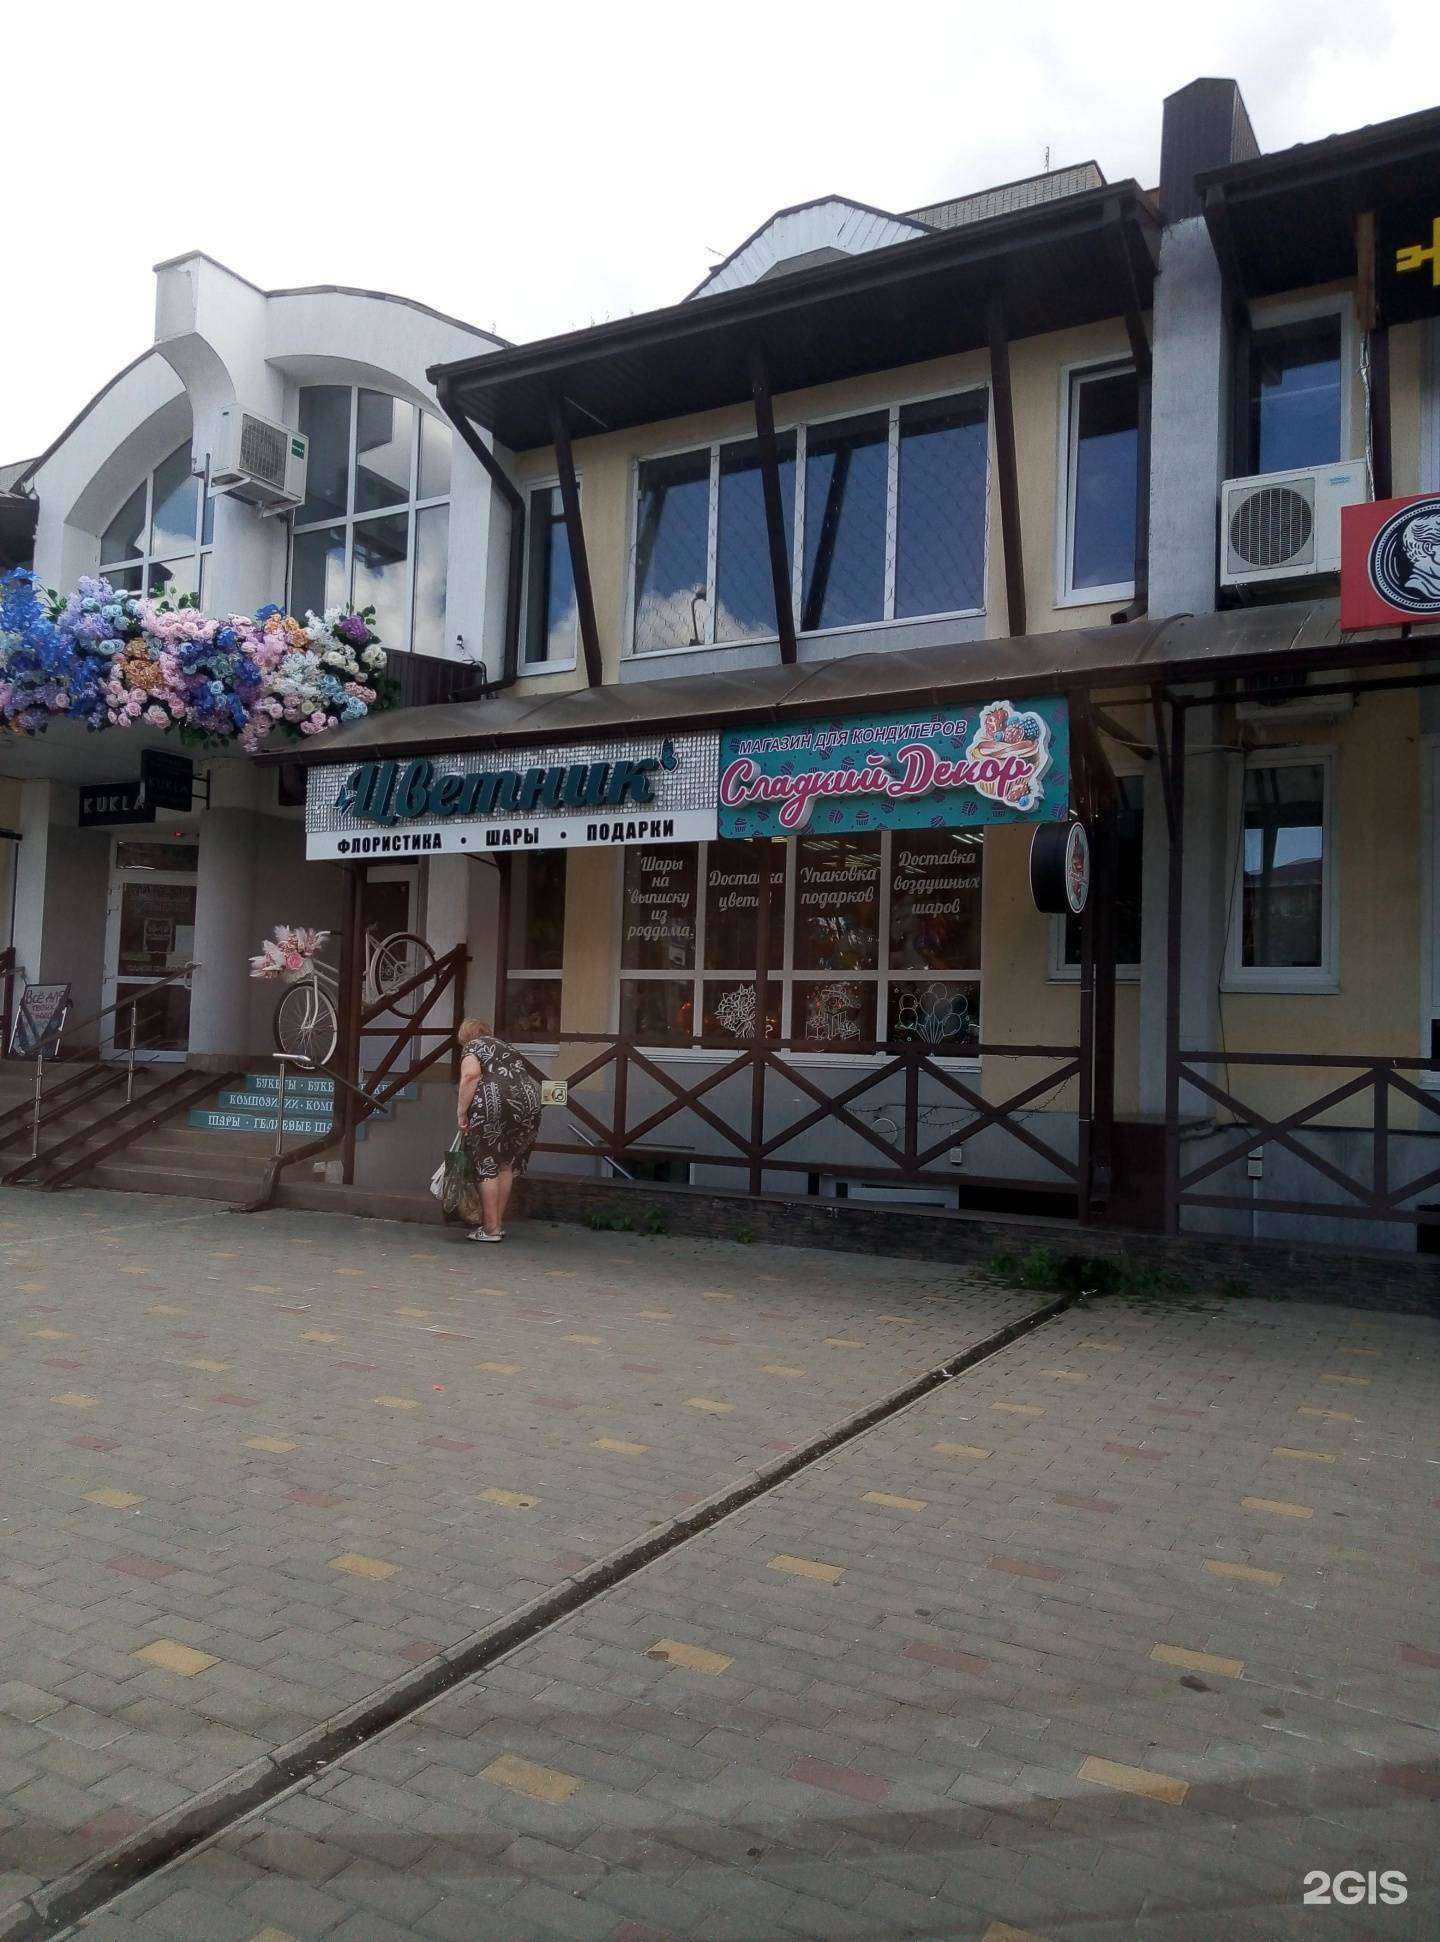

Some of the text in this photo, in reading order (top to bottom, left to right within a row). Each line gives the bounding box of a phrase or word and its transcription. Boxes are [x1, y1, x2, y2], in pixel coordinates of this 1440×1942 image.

[739, 719, 968, 754] МАГАЗИН ДЛЯ КОНДИТЕРОВ
[345, 757, 660, 826] Цветник
[720, 742, 1032, 828] Сладкий Декор
[83, 793, 145, 813] KUKLA
[485, 827, 540, 846] ШАРЫ
[586, 819, 675, 842] ПОДАРКИ
[337, 832, 443, 854] ФЛОРИСТИКА
[640, 856, 684, 876] Шары
[899, 849, 977, 867] Доставка
[651, 877, 670, 888] на
[709, 870, 784, 887] Достаа
[800, 865, 878, 884] Упаковка
[893, 875, 982, 895] воздушных
[630, 889, 690, 908] выписку
[718, 891, 773, 912] цвет
[800, 886, 875, 909] подарков
[651, 908, 668, 923] из
[911, 898, 961, 917] шаров
[256, 1077, 296, 1090] БУКЕЫ
[229, 1094, 299, 1109] КОМПОЗИИИ
